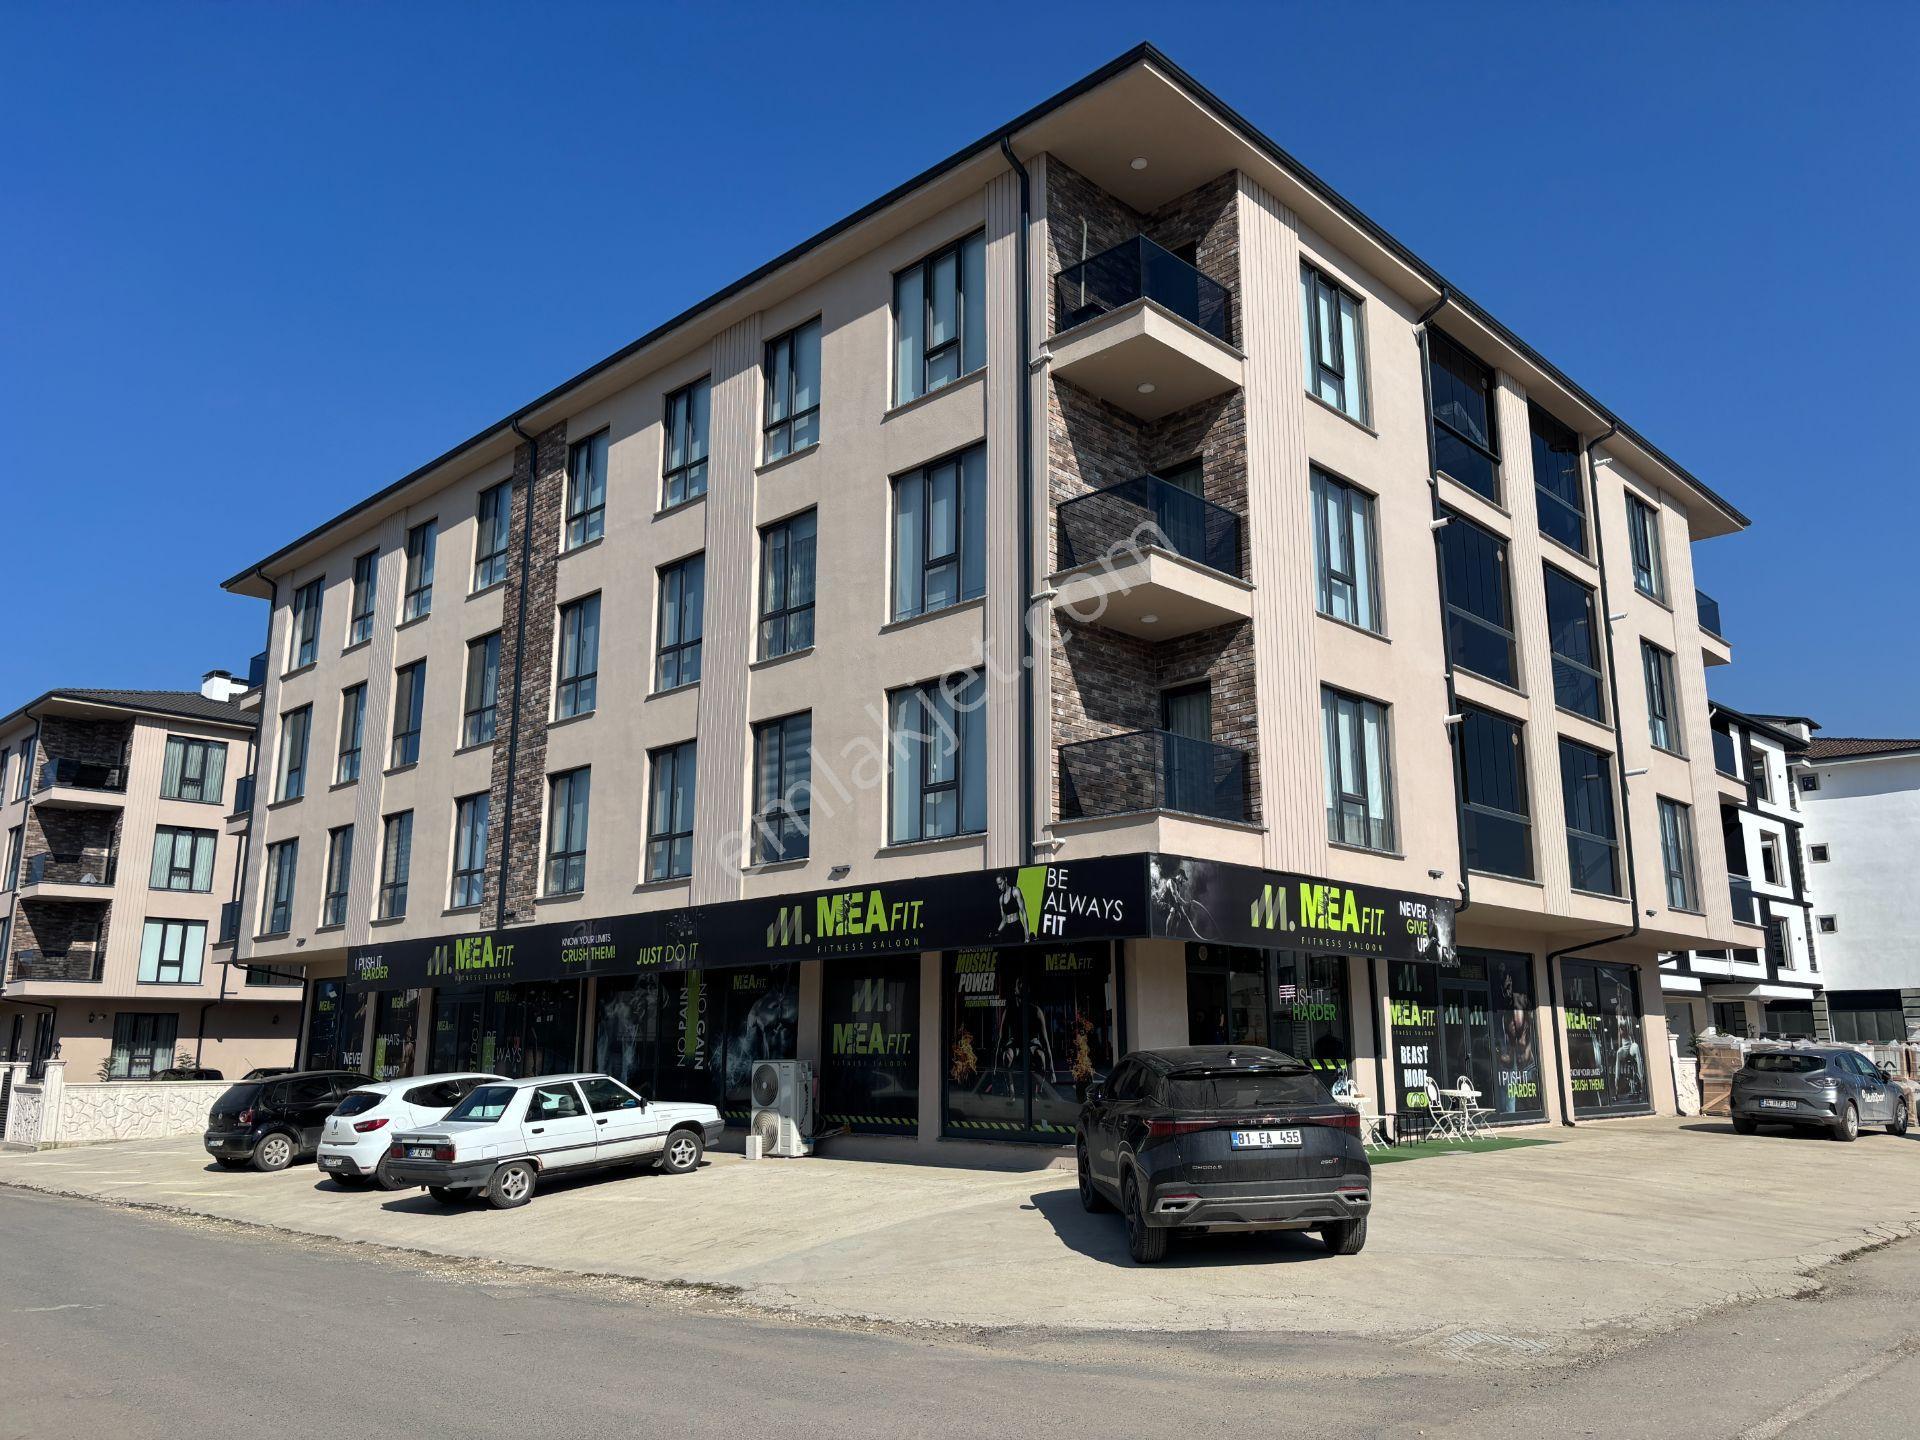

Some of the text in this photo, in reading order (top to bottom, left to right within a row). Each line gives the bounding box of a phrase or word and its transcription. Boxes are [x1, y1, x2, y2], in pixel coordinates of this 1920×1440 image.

[1047, 867, 1069, 889] BE
[1044, 891, 1124, 921] ALWAYS
[1400, 901, 1427, 919] NEVER
[1042, 913, 1067, 936] FIT
[1406, 918, 1428, 936] GIVE
[561, 933, 611, 947] KNOW YOUR LIMITS
[817, 938, 919, 953] FITNESS SALOON
[1301, 936, 1383, 952] FITNESS SALOON
[1417, 937, 1428, 953] UP
[358, 956, 376, 970] PUSH
[376, 955, 383, 968] IT
[561, 945, 616, 963] CRUSH THEM!
[637, 942, 699, 965] JUST DO IT
[955, 951, 999, 973] MUSCLE
[361, 966, 389, 980] HARDER
[958, 972, 996, 992] POWER
[1293, 1003, 1337, 1021] HARDER
[676, 987, 690, 1067] NO PAIN
[694, 983, 707, 1070] NO GAIN
[1400, 1045, 1429, 1064] BEAST
[1502, 1070, 1522, 1086] PUSH
[1522, 1070, 1528, 1084] IT
[1507, 1082, 1537, 1098] HARDER
[1237, 1117, 1293, 1125] CHERY
[1238, 1131, 1300, 1145] 81 EA 455
